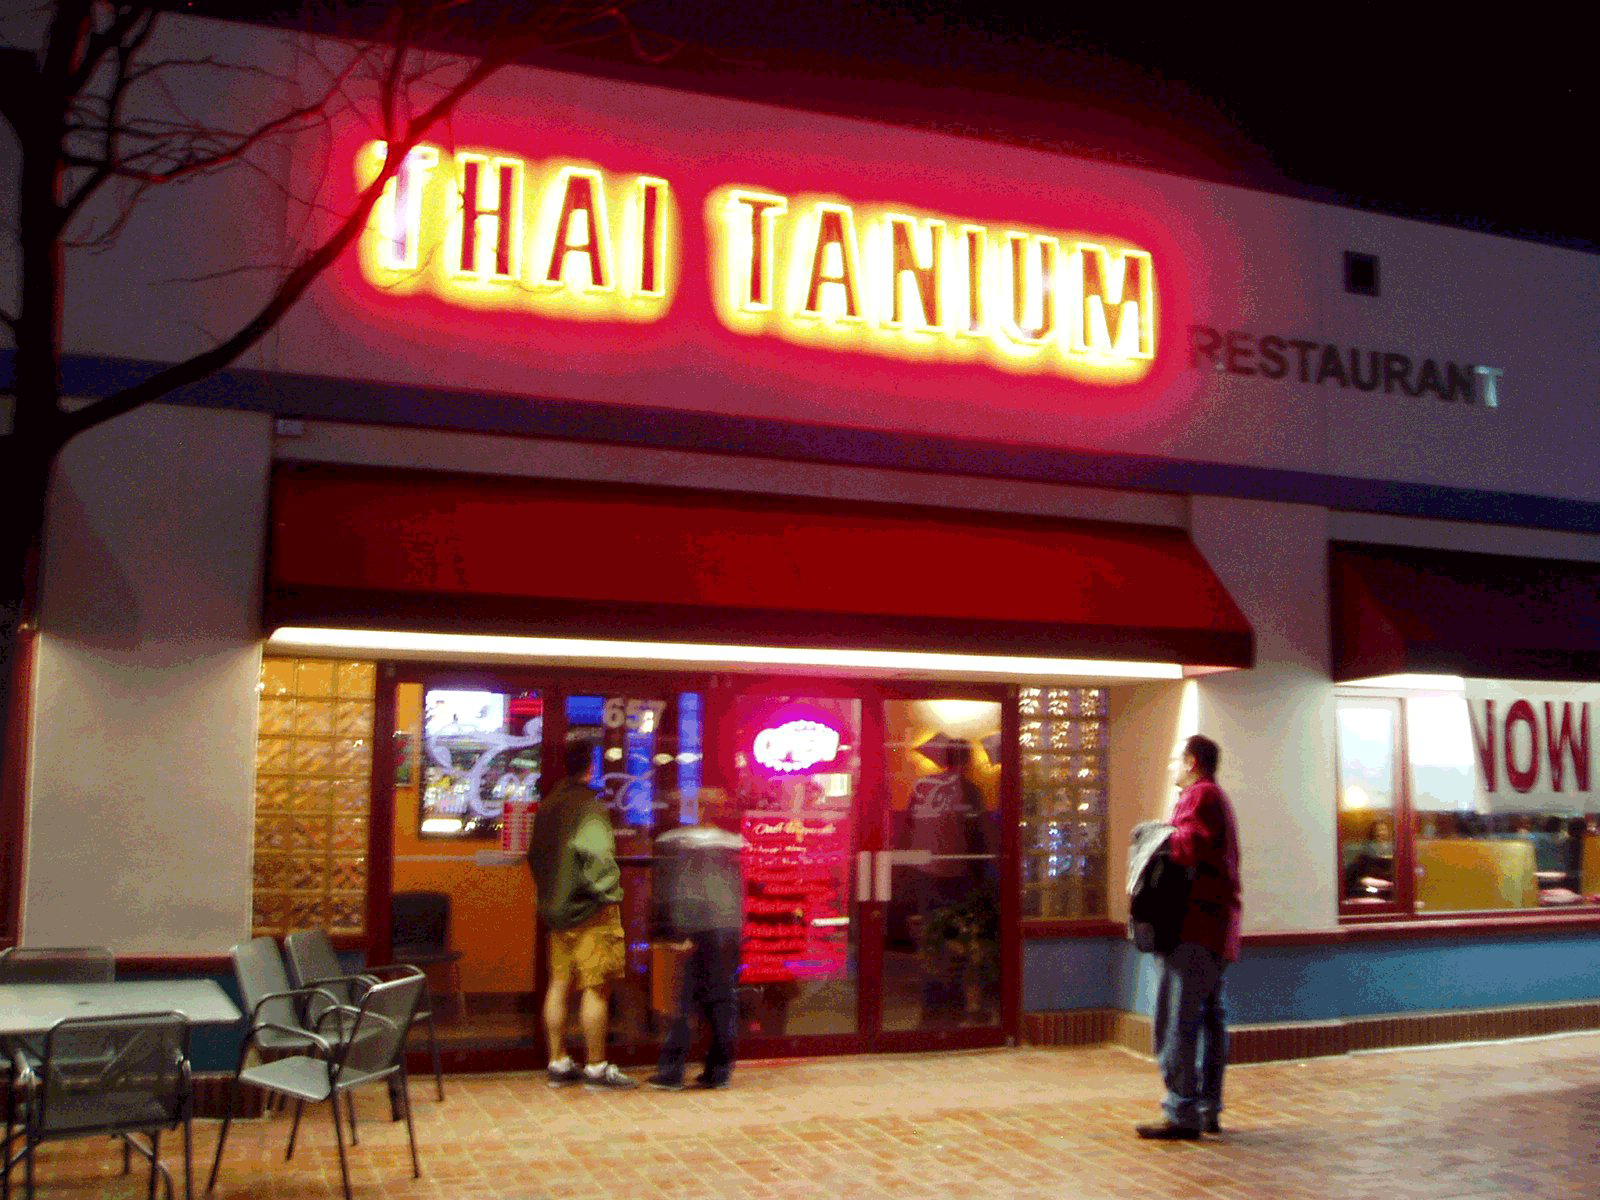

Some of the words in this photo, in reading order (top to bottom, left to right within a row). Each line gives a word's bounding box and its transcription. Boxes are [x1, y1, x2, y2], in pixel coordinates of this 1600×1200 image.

[367, 140, 669, 297] THAI
[728, 189, 1155, 360] TANIUM
[1186, 324, 1504, 408] RESTAURANT
[604, 698, 667, 729] 657
[1467, 699, 1591, 793] NOW
